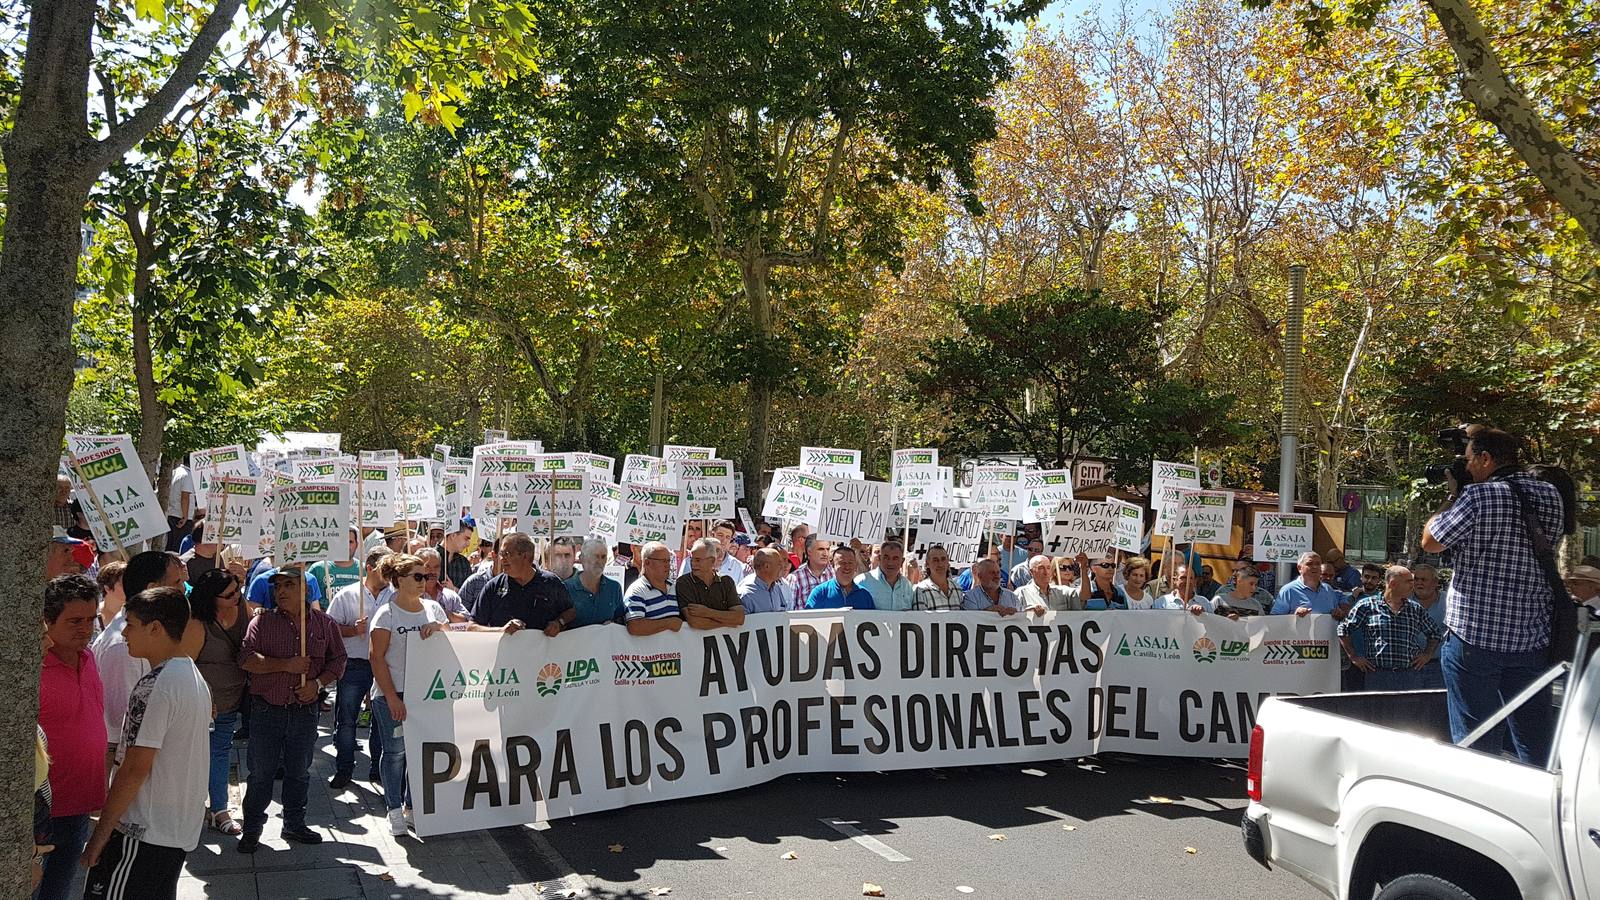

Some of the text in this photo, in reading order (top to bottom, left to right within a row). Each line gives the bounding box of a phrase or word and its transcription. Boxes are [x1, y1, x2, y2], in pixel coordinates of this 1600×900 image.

[68, 446, 121, 467] CMPESINOS
[216, 453, 236, 462] UCCL
[82, 458, 123, 480] UCCL
[593, 460, 607, 468] UCCL
[403, 466, 423, 475] UCCL
[903, 471, 931, 480] ASAJA
[1082, 466, 1102, 478] CITY
[496, 482, 518, 492] ASA
[558, 480, 580, 489] UCCL
[803, 478, 820, 489] UCCL
[228, 484, 252, 494] UCCL
[695, 486, 727, 494] ASAJA
[908, 488, 924, 496] UPA
[990, 489, 1016, 498] ASAJA
[307, 494, 336, 504] UCCL
[656, 495, 676, 505] UCCL
[787, 492, 817, 504] ASAJA
[1040, 491, 1068, 500] ASAJA
[122, 501, 145, 514] León
[502, 502, 518, 512] UP
[543, 500, 581, 510] ASAJA
[702, 504, 720, 514] UPA
[992, 505, 1010, 514] UPA
[1058, 502, 1120, 518] MINISTRA
[790, 506, 807, 517] UPA
[1124, 508, 1137, 517] UCCL
[640, 510, 676, 524] ASAJA
[1192, 513, 1224, 522] ASAJA
[290, 517, 338, 530] ASAJA
[554, 520, 573, 530] UPA
[597, 521, 614, 532] UPA
[1072, 518, 1114, 533] PASEAR
[646, 531, 666, 542] UPA
[1197, 530, 1216, 538] UPA
[1274, 534, 1306, 542] ASAJA
[1063, 537, 1110, 554] TRABAJAR
[1119, 537, 1131, 546] UPA
[300, 541, 328, 554] UPA
[1280, 549, 1299, 558] UPA
[1134, 636, 1180, 650] ASAJA
[1220, 640, 1250, 656] UPA
[612, 654, 630, 662] UNIÓN
[641, 652, 681, 661] CAMPESINOS
[1133, 650, 1157, 659] Castilla
[1164, 652, 1180, 660] León
[1302, 648, 1328, 658] UCCL
[700, 620, 1104, 697] AYUDAS DIRECTAS
[564, 658, 600, 683] UPA
[652, 664, 678, 676] UCCL
[451, 668, 520, 687] ASAJA
[450, 688, 520, 700] Castilla y León
[422, 728, 582, 814] PARA
[599, 717, 686, 790] LOS
[702, 688, 1072, 775] PROFESIONALES
[1088, 685, 1159, 740] DEL
